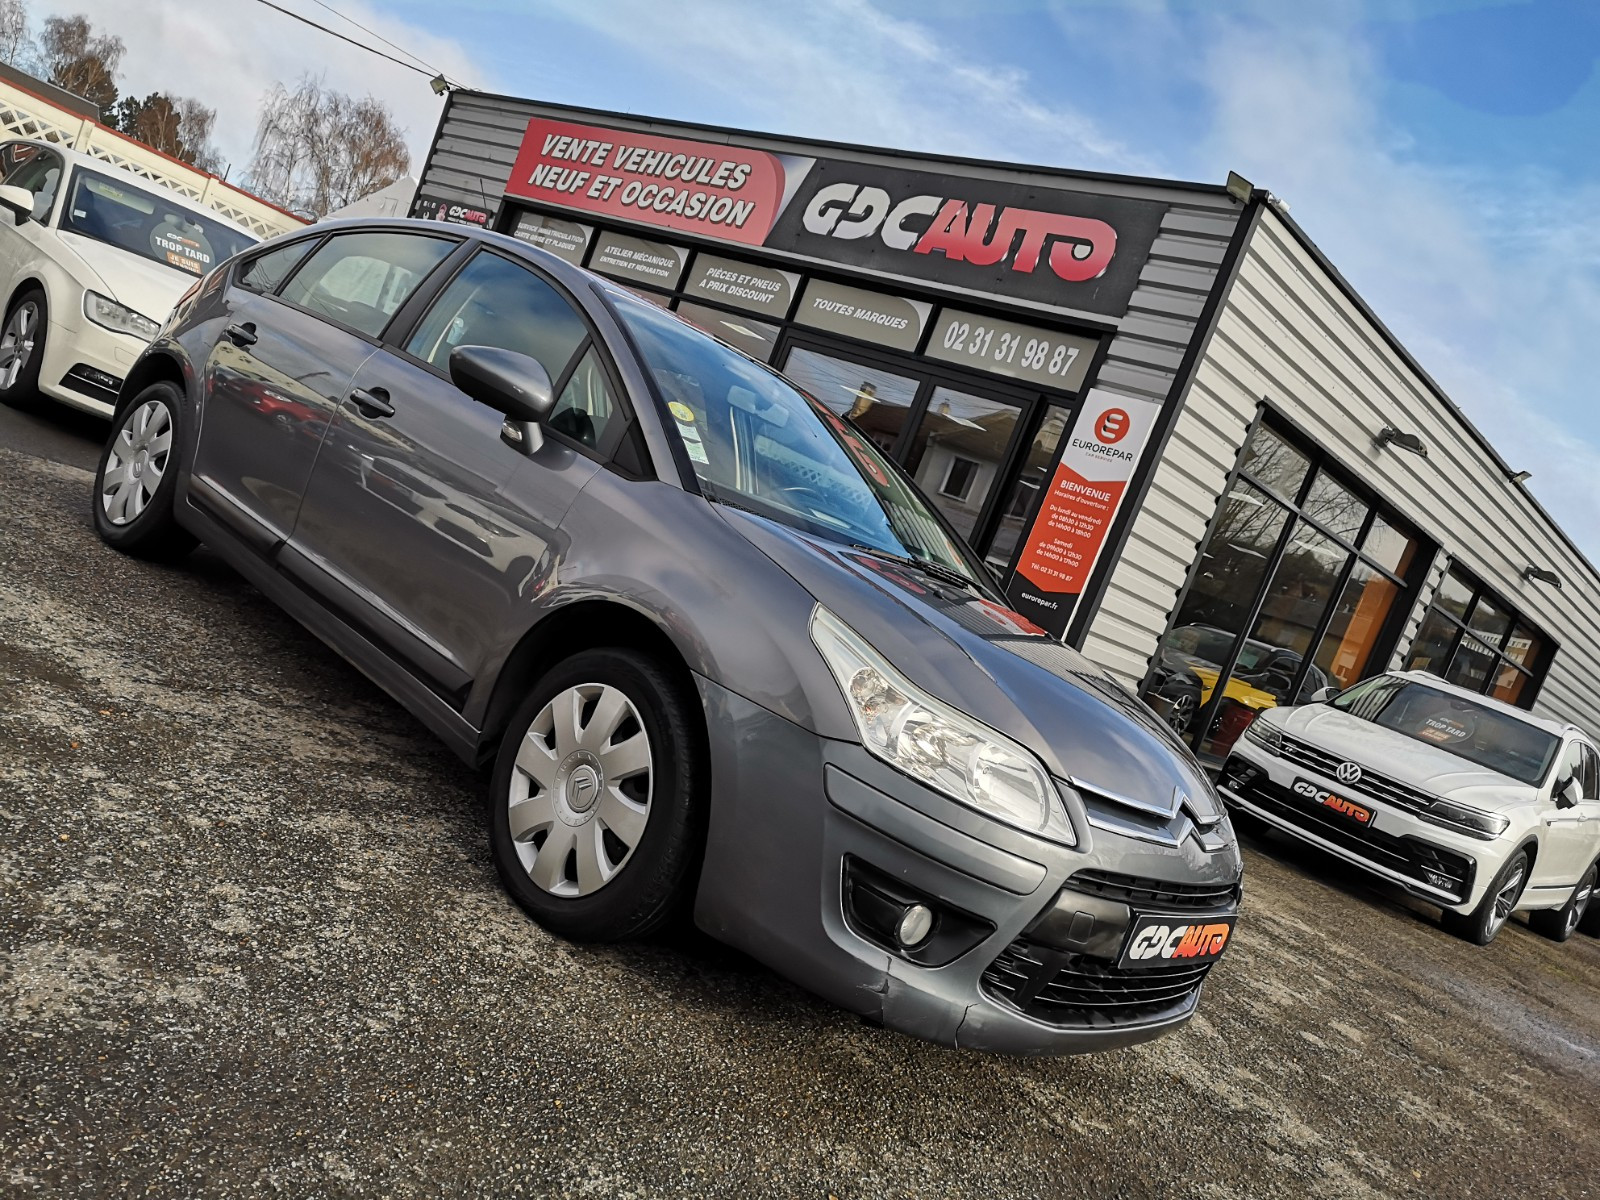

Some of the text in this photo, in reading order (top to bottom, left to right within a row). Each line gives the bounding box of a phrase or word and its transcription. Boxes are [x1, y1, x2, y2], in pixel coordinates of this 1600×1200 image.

[541, 134, 751, 190] VENTE VEHICULES
[528, 164, 755, 227] NEUF ET OCCASION
[517, 222, 539, 232] SERVICE
[155, 236, 183, 252] TROP
[184, 246, 210, 264] TARD
[514, 231, 531, 240] CARTE
[551, 240, 576, 251] PLAQUES
[600, 256, 628, 268] ENTRETIEN
[634, 264, 669, 277] RÉPARATION
[604, 246, 675, 268] ATELIER MÉCANIQUE
[706, 267, 781, 292] PIÈCES ET PNEUS
[699, 279, 775, 303] A PRIX DISCOUNT
[813, 298, 908, 330] TOUTES MARQUES
[943, 321, 1080, 376] 02 31 31 98 87
[1072, 438, 1133, 461] EUROREPAR
[1054, 489, 1075, 501] Horaires
[1075, 496, 1107, 510] d'ouverture
[1060, 480, 1111, 502] BIENVENUE
[1058, 506, 1071, 515] lundi
[1078, 514, 1102, 525] vendredi
[1079, 522, 1094, 531] 12h30
[1053, 538, 1073, 549] Samedi
[1043, 551, 1059, 560] 14h00
[1021, 592, 1058, 610] eurorepar.fr
[1425, 718, 1447, 729] TROP
[1445, 726, 1466, 737] TARD
